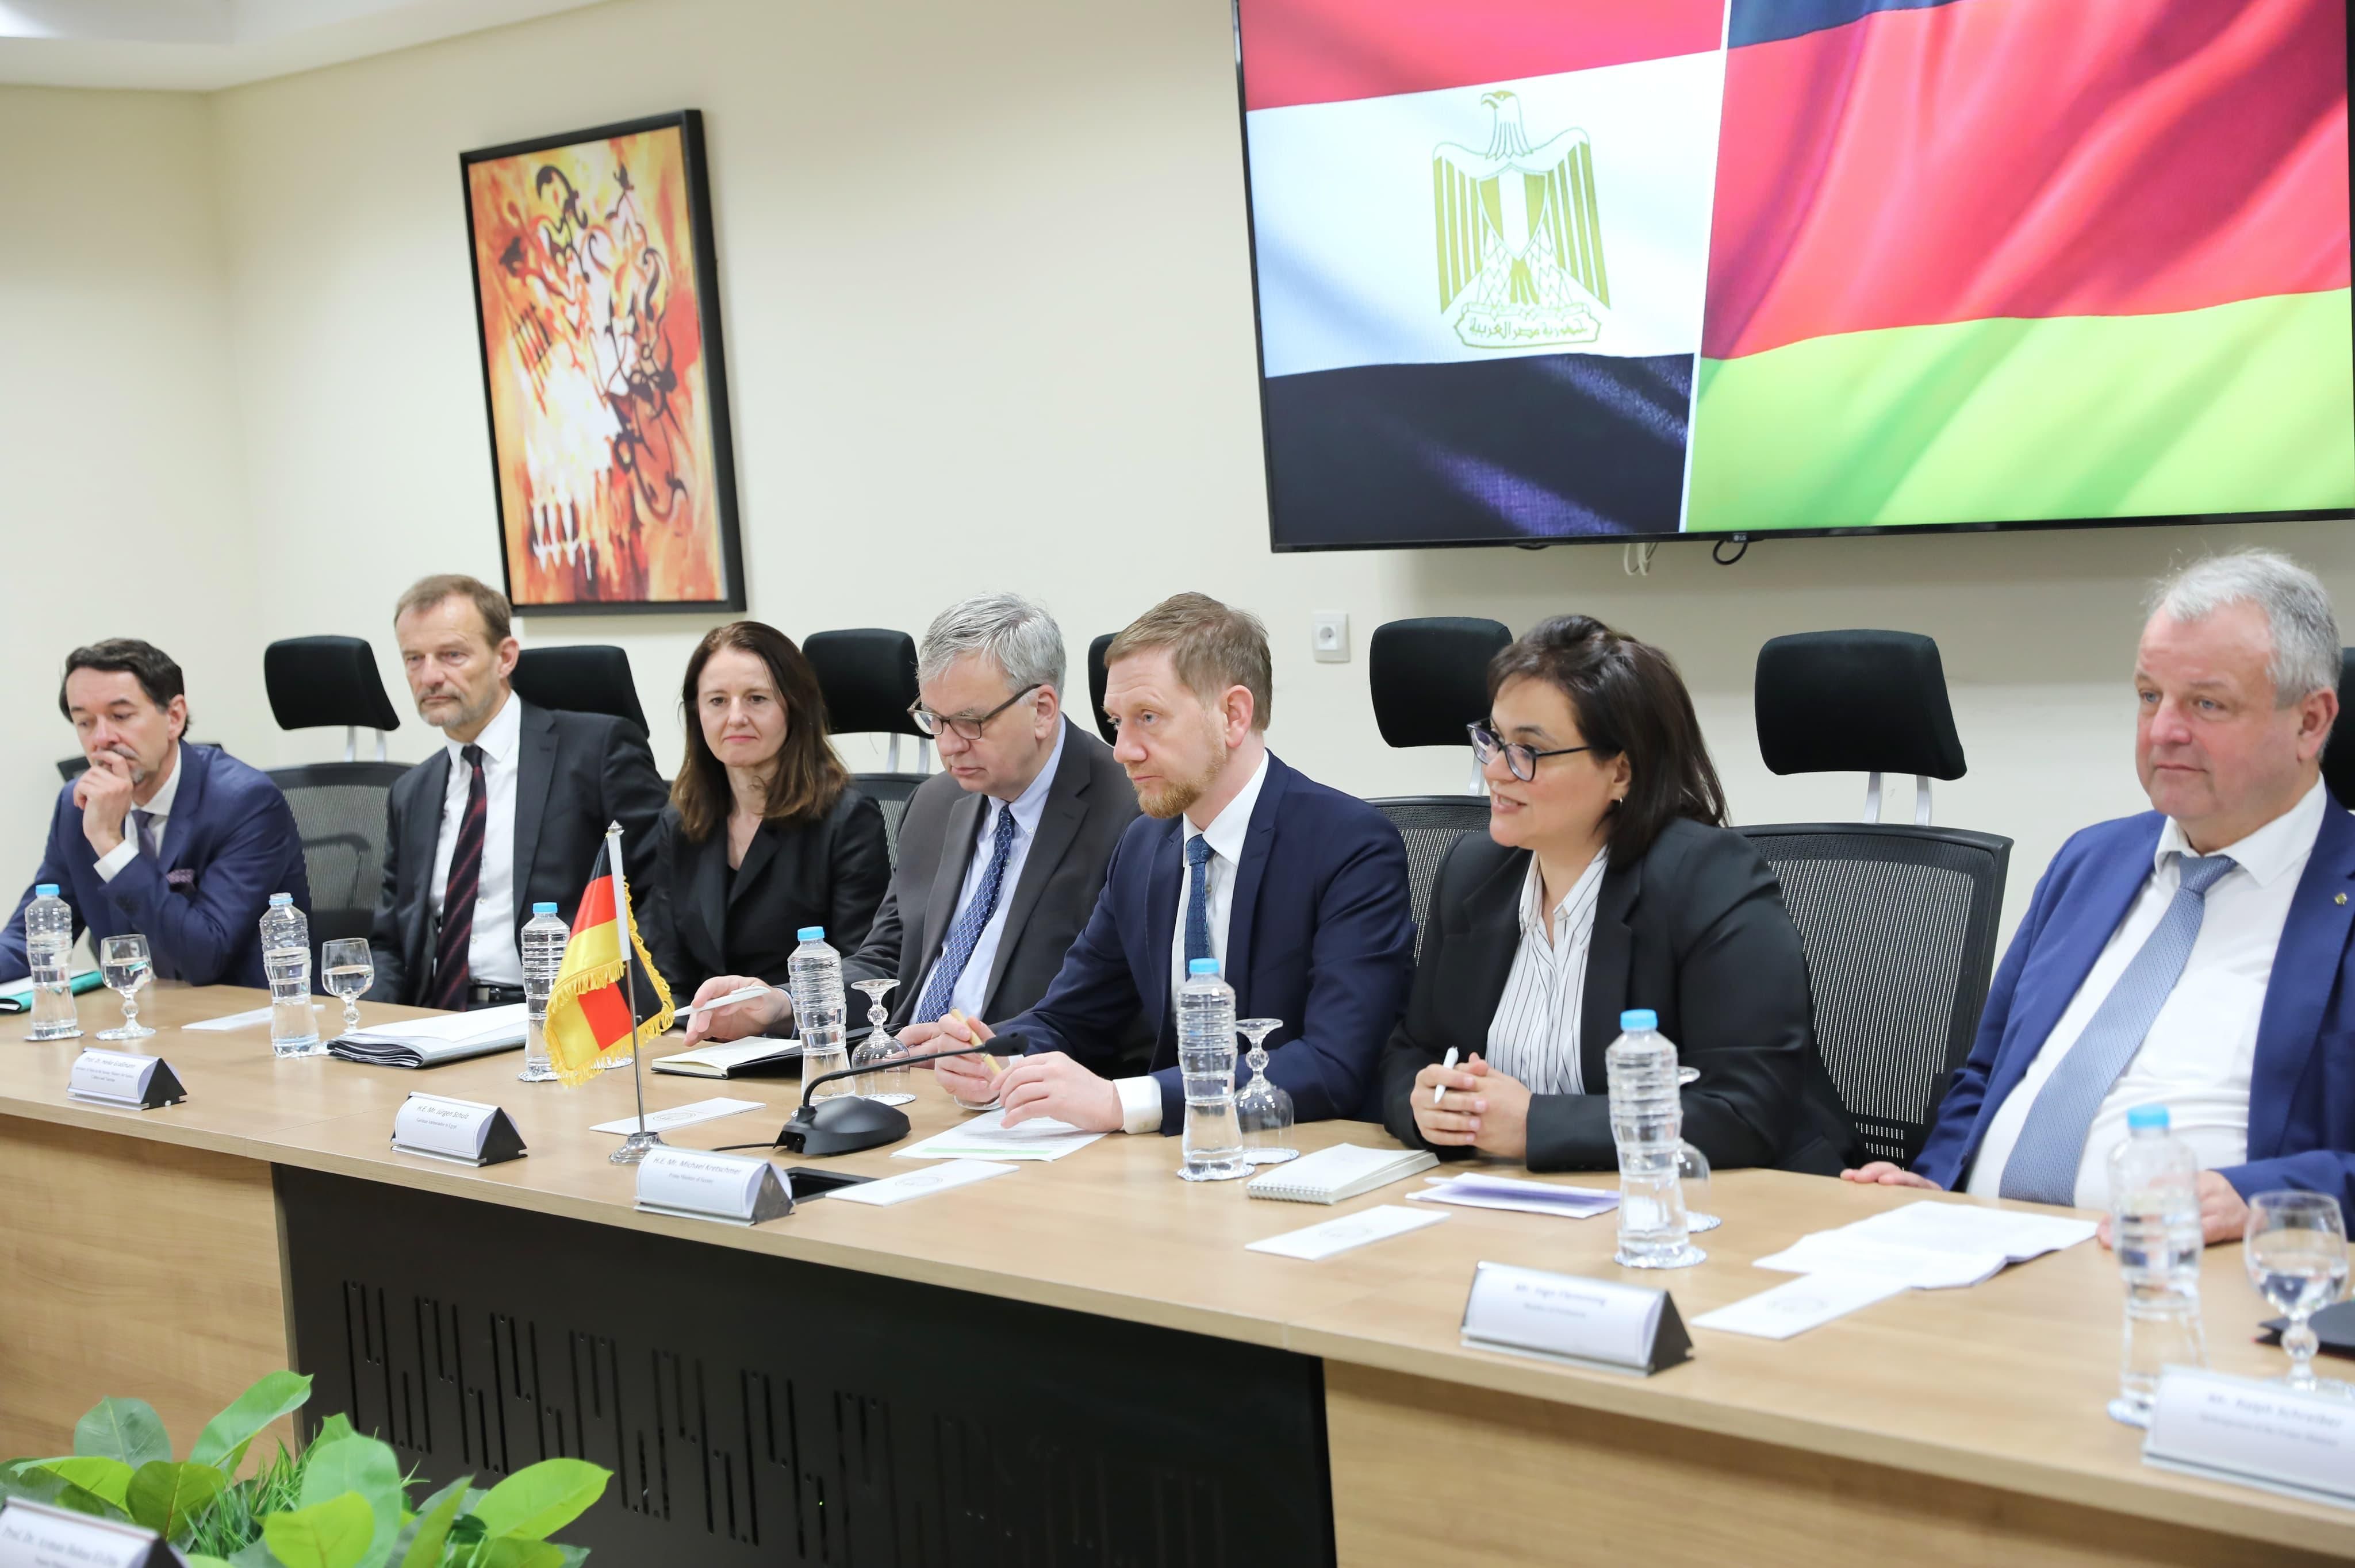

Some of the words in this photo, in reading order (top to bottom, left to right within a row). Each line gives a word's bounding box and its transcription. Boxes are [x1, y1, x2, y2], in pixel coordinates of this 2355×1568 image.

[1469, 317, 1512, 339] العربية
[1512, 326, 1540, 340] مصر
[666, 1158, 677, 1166] Mr.
[680, 1160, 705, 1170] Michael
[705, 1164, 742, 1175] Kretschmer
